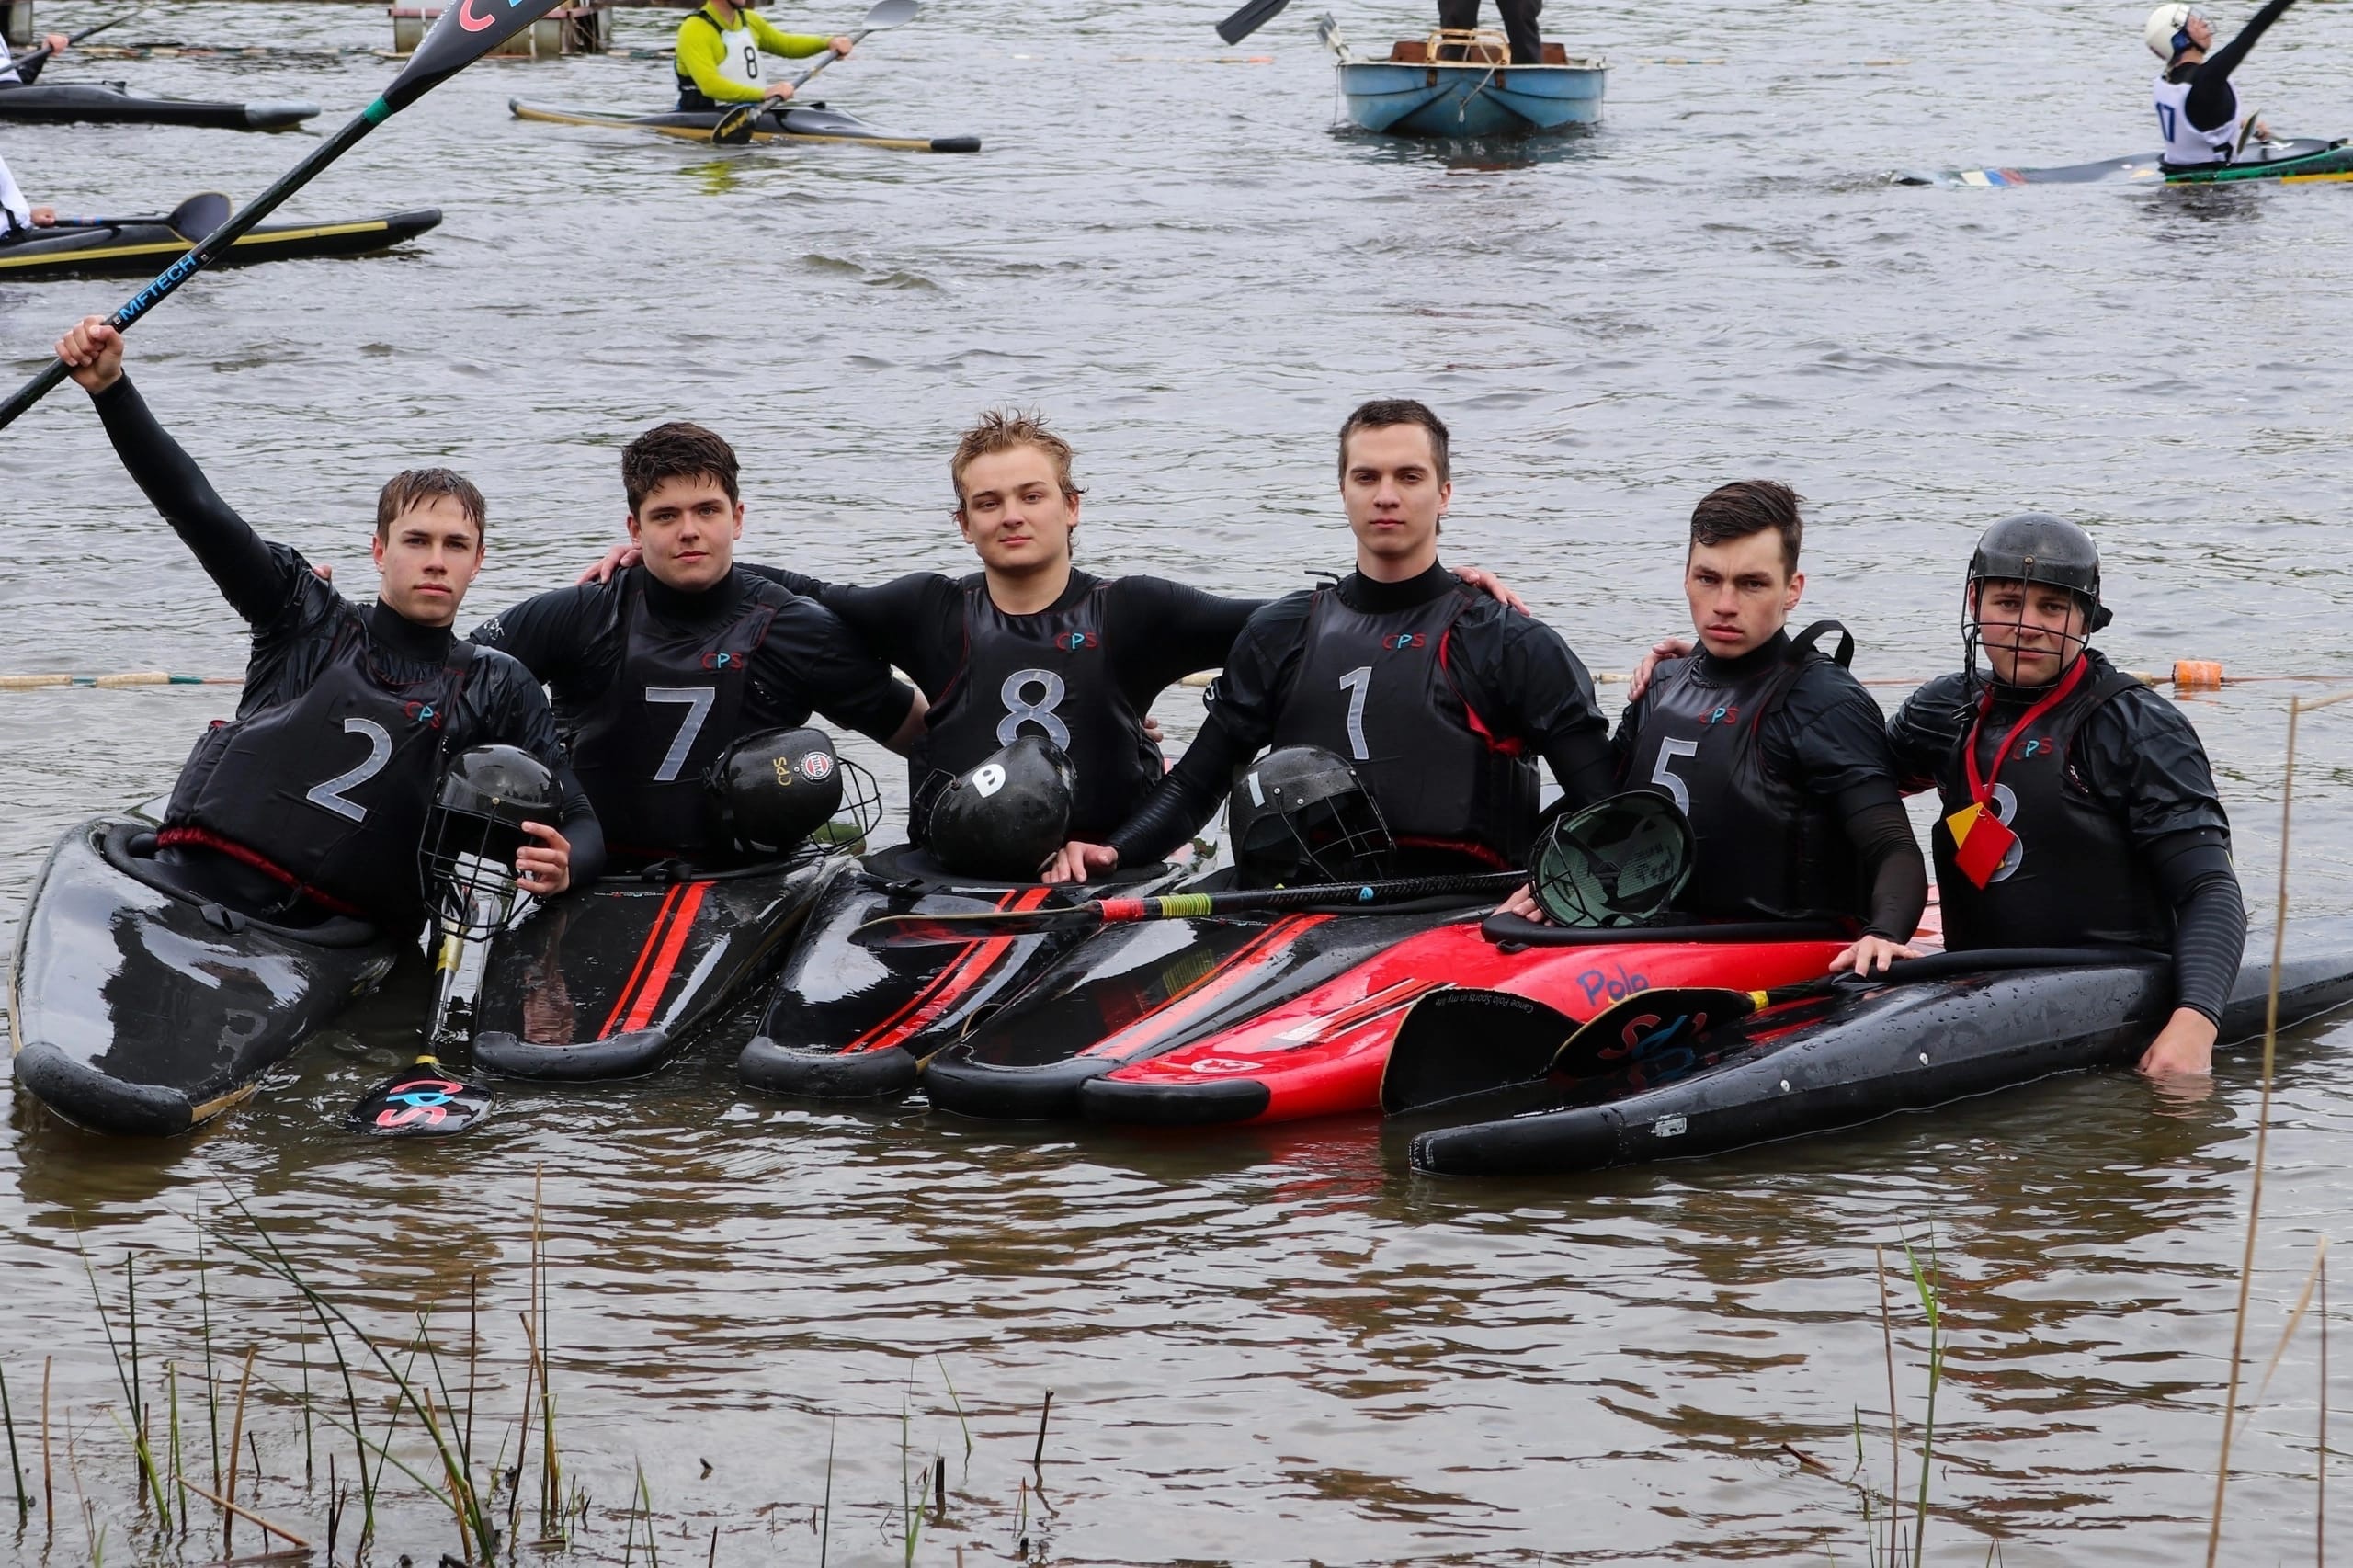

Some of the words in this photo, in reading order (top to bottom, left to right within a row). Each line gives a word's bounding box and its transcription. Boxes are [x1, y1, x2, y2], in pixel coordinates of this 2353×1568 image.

[744, 46, 758, 79] 8
[2155, 102, 2175, 142] 17
[119, 255, 197, 321] MFTECH
[1057, 632, 1098, 651] CPS
[1382, 633, 1426, 649] CPS
[701, 653, 744, 670] CPS
[404, 701, 441, 728] CPS
[996, 669, 1070, 751] 8
[1339, 666, 1372, 760] 1
[1699, 707, 1740, 724] CPS
[645, 687, 716, 781] 7
[2013, 737, 2053, 760] CPS
[306, 718, 392, 823] 2
[773, 756, 792, 786] CPS
[1651, 736, 1699, 817] 5
[1448, 994, 1459, 1003] my
[1576, 963, 1650, 1006] Polo
[1435, 997, 1447, 1007] life
[1468, 994, 1493, 1006] Sports
[1492, 996, 1509, 1007] Polo
[1510, 999, 1534, 1013] Canoe
[376, 1080, 464, 1127] CPS
